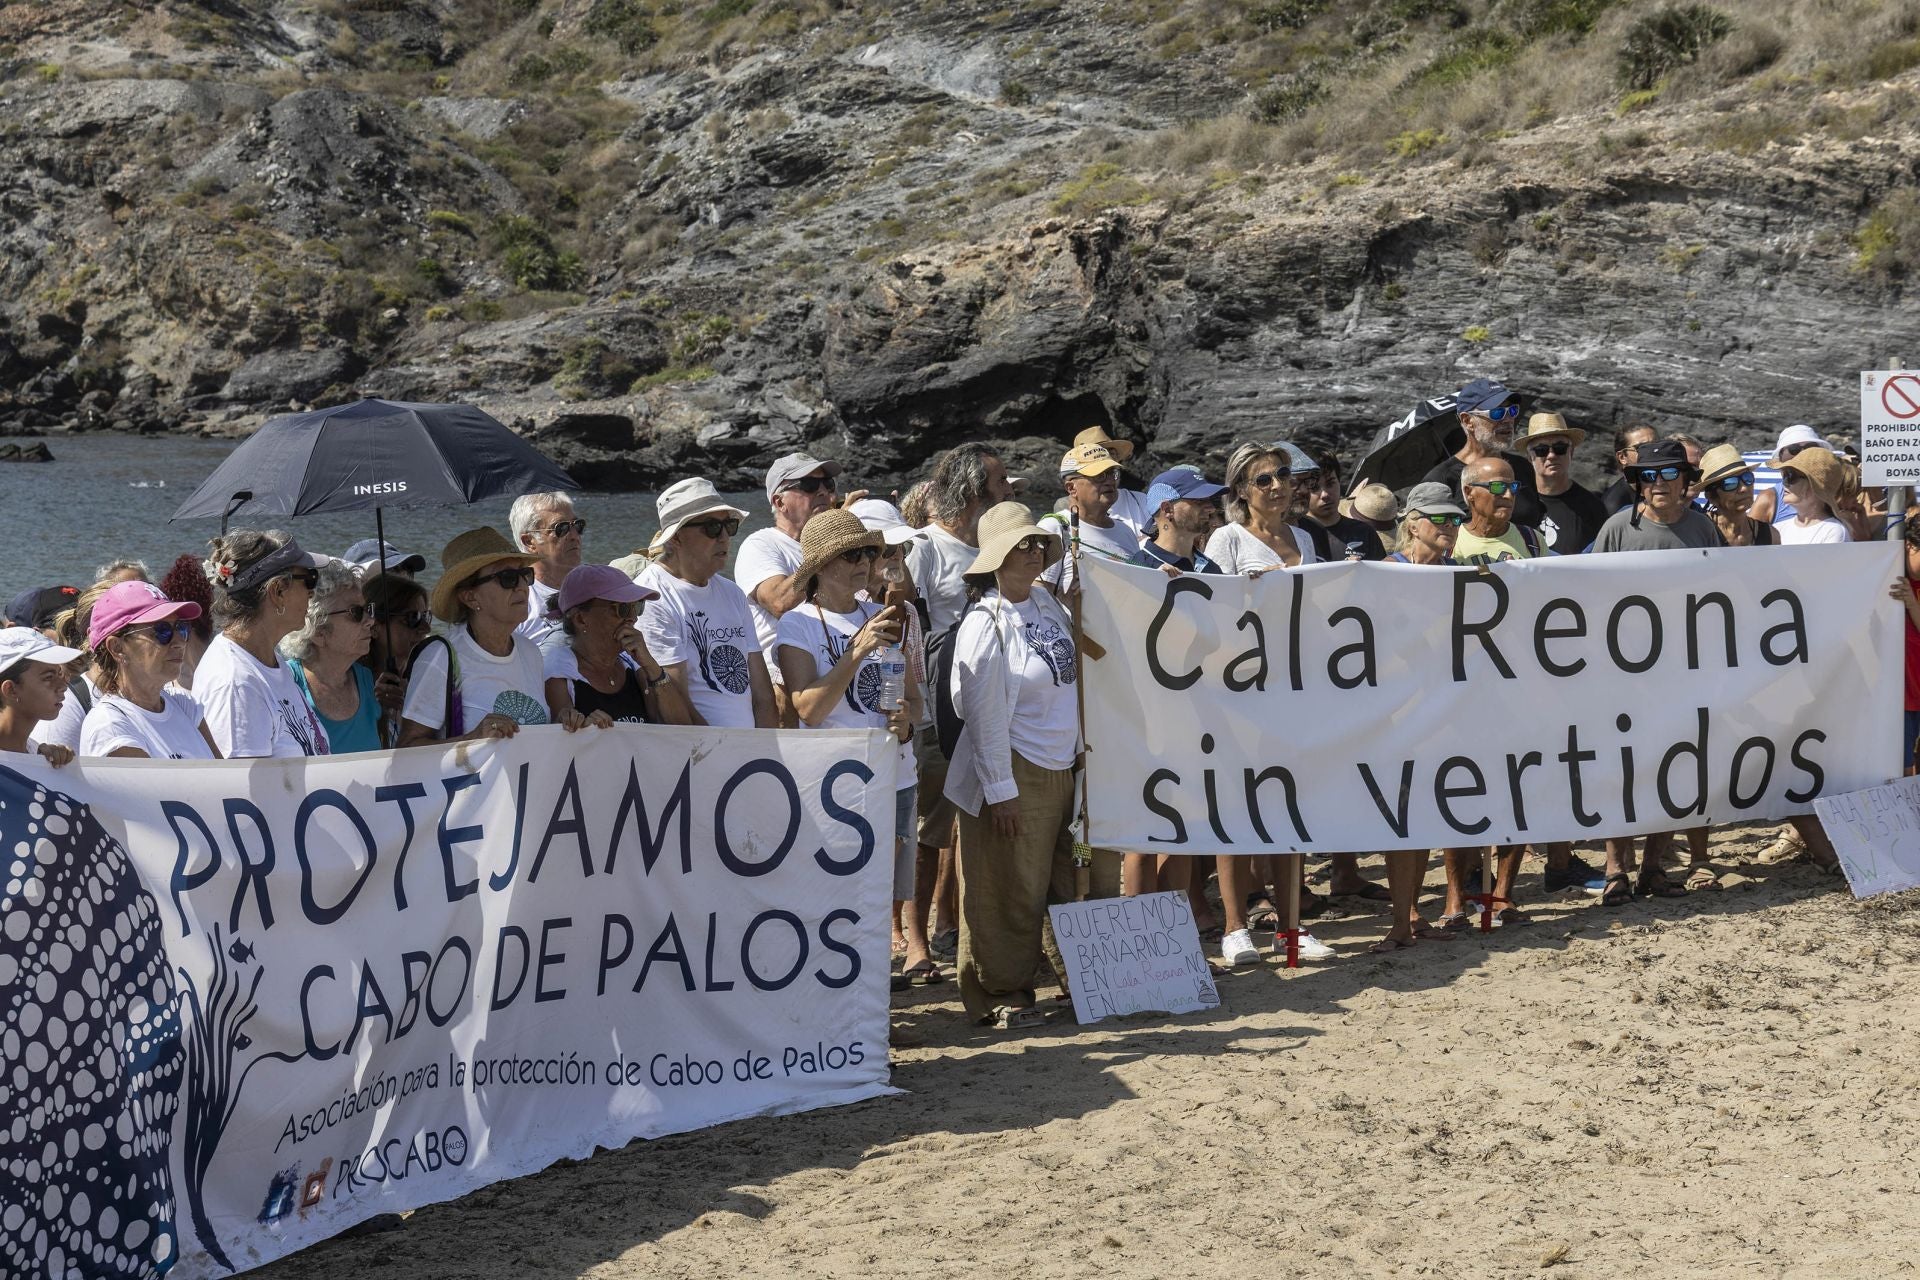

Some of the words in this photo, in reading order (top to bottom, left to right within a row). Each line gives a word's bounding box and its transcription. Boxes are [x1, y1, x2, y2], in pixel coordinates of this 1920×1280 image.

[1865, 437, 1894, 448] BAÑO
[1897, 438, 1911, 447] EN
[1865, 453, 1915, 463] ACOTADA
[354, 481, 407, 495] INESIS
[1886, 468, 1920, 477] BOYAS
[1145, 573, 1378, 692] Cala
[1451, 570, 1809, 682] Reona
[1142, 732, 1313, 844] sin
[1356, 706, 1827, 839] vertidos
[159, 755, 875, 938] PROTEJAMOS
[1058, 890, 1189, 939] QUEREMOS
[1077, 929, 1183, 970] BAÑARNOS
[1080, 967, 1110, 993] EN
[1185, 950, 1208, 974] NO
[299, 935, 472, 1061] CABO
[490, 916, 573, 1012] DE
[597, 908, 862, 997] PALOS
[1087, 991, 1117, 1020] EN
[275, 1070, 397, 1151] Asociación
[398, 1062, 439, 1105] para
[449, 1053, 467, 1088] la
[472, 1051, 596, 1093] protección
[605, 1053, 641, 1087] de
[650, 1053, 724, 1087] Cabo
[733, 1050, 774, 1082] de
[783, 1041, 866, 1077] Palos
[332, 1125, 468, 1199] PROCABO
